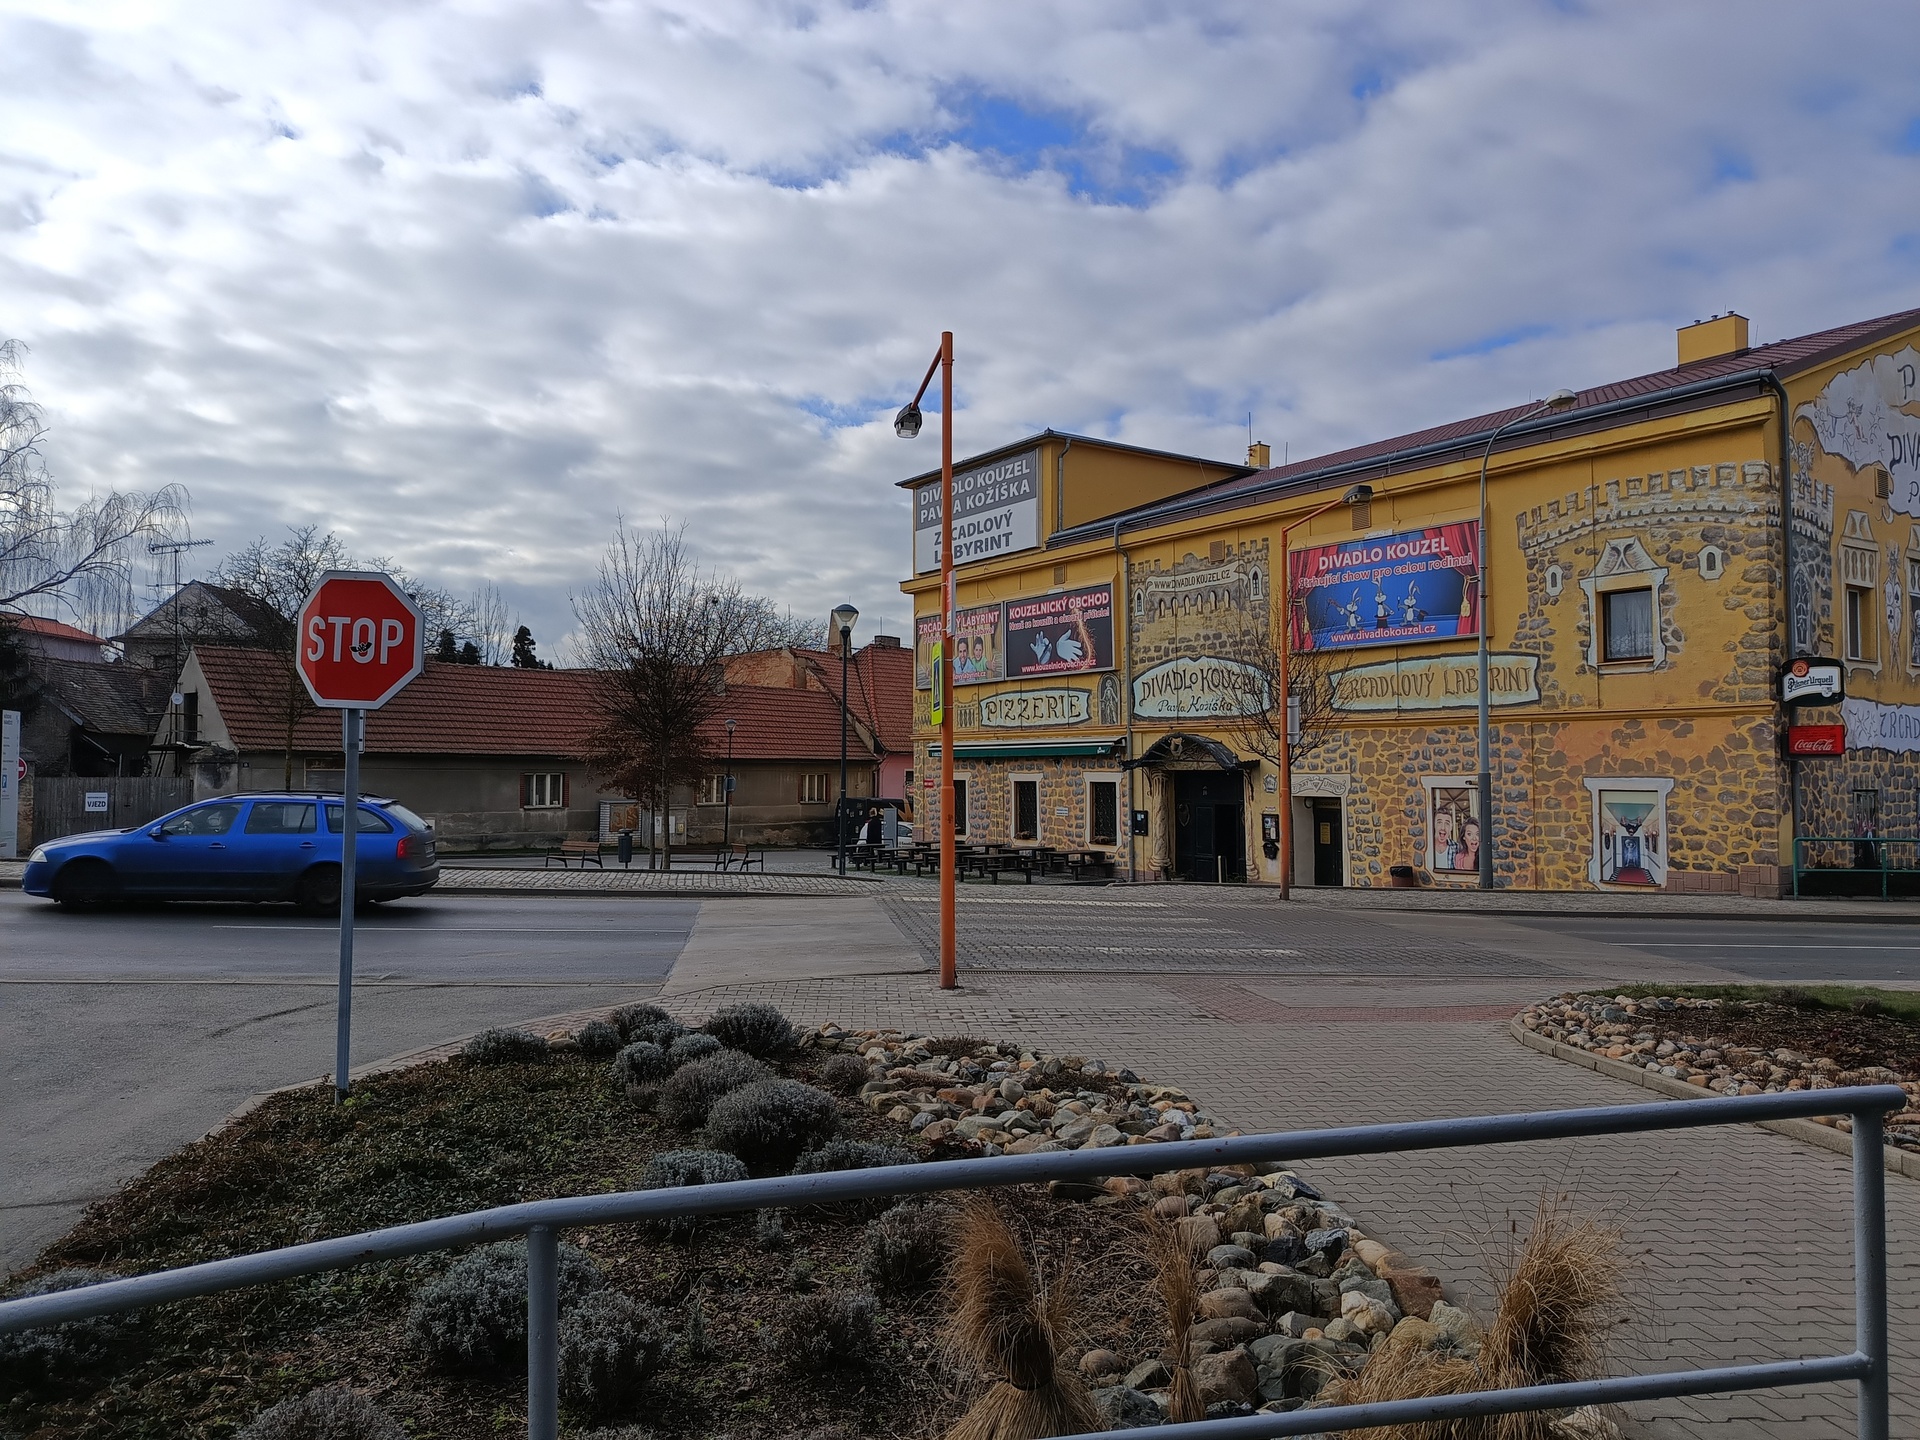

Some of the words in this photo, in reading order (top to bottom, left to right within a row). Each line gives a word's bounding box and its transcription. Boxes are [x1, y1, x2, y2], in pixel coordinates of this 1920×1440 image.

[920, 477, 974, 506] DIVDLO
[977, 460, 1030, 488] KOUZEL
[920, 500, 962, 524] PAVA
[966, 479, 1030, 510] KOŽÍŠKA
[934, 509, 1013, 546] ZCADLOVÝ
[934, 532, 1013, 564] LBYRINT
[1318, 547, 1383, 571] DIVADLO
[1386, 537, 1450, 560] KOUZEL
[1342, 569, 1371, 583] show
[1373, 564, 1391, 580] pro
[1393, 560, 1427, 575] celou
[1428, 552, 1473, 571] rodinu!
[962, 610, 1000, 628] LABYRINT
[1010, 597, 1067, 620] KOUZELNICKÝ
[1068, 592, 1110, 609] OBCHOD
[307, 615, 404, 664] STOP
[1331, 623, 1436, 643] www.divadlokouzel.cz
[1139, 669, 1198, 707] DIVADLO
[1442, 667, 1531, 696] LABRINT
[1809, 675, 1834, 687] Urquell
[985, 694, 1081, 722] PIZZERIE
[1158, 700, 1186, 713] Pavla
[1794, 739, 1834, 751] Coca-Cola
[87, 800, 107, 808] VJEZD
